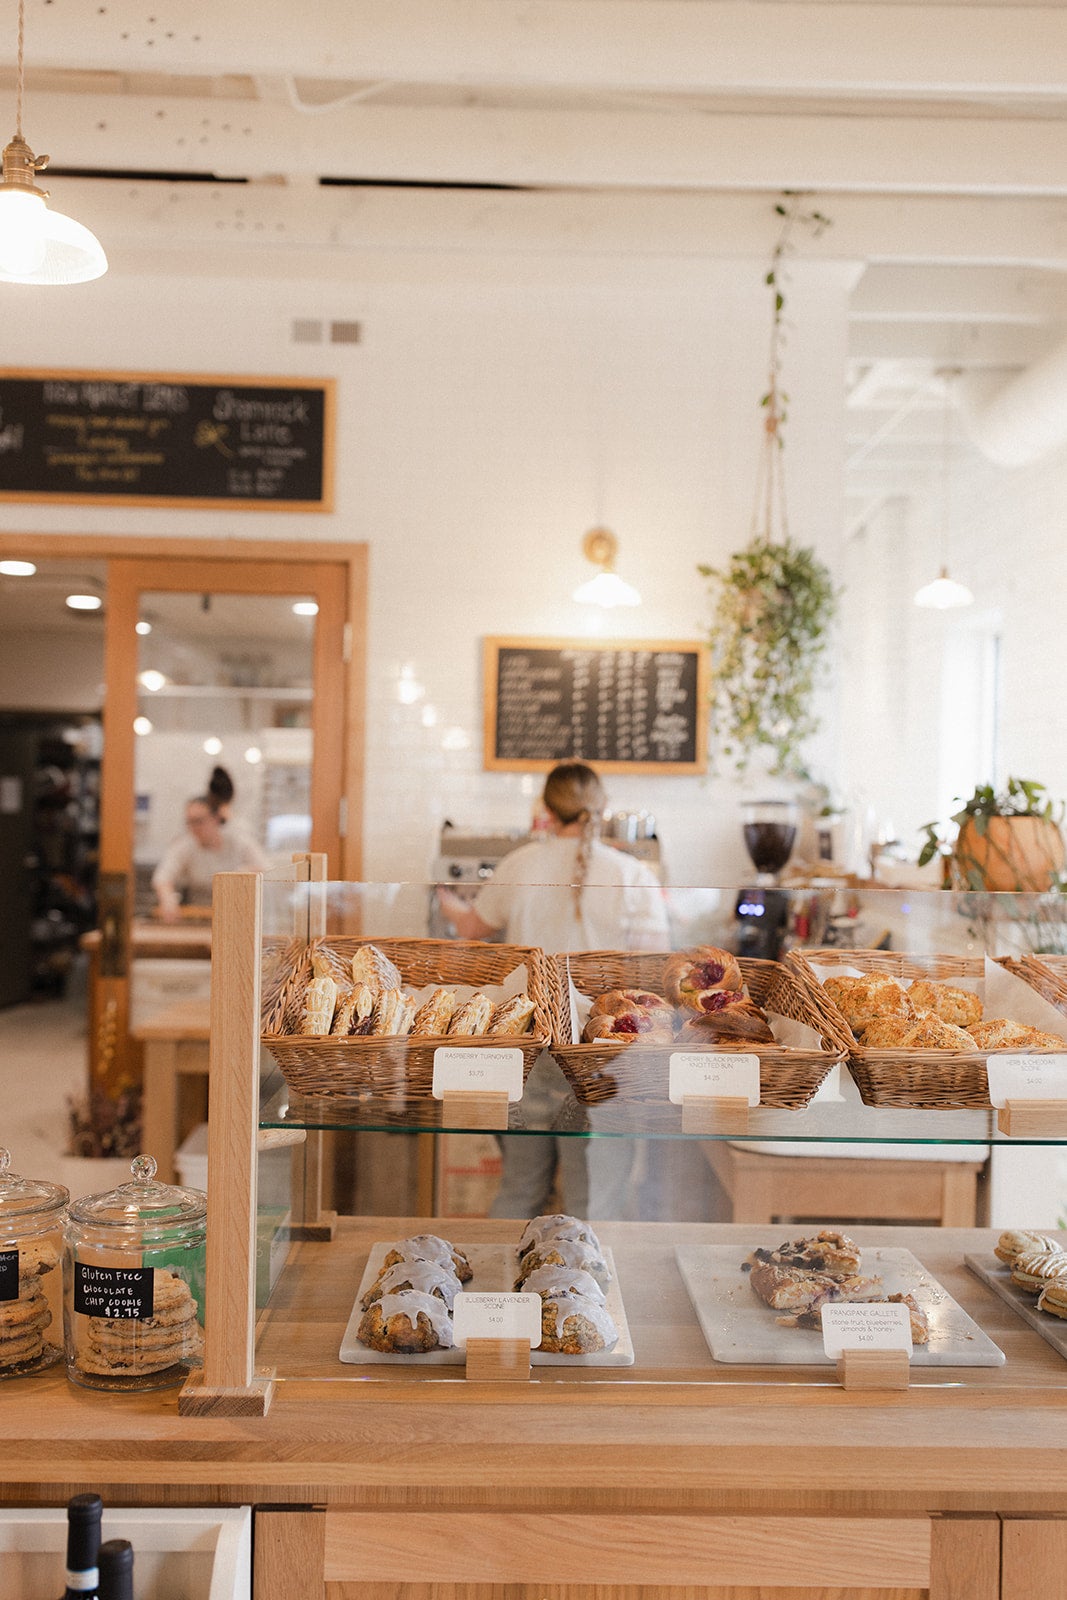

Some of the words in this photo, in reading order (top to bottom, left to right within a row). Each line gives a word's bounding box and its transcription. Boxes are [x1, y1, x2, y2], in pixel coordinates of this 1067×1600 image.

[444, 1052, 478, 1060] RASPBERRY
[480, 1053, 514, 1061] TURNOVER
[81, 1266, 112, 1280] Gluten
[116, 1271, 143, 1281] Free
[83, 1284, 134, 1295] CHOCOLATE
[84, 1297, 105, 1306] CHIP
[108, 1298, 142, 1307] COOKIE
[105, 1306, 140, 1317] $2.75
